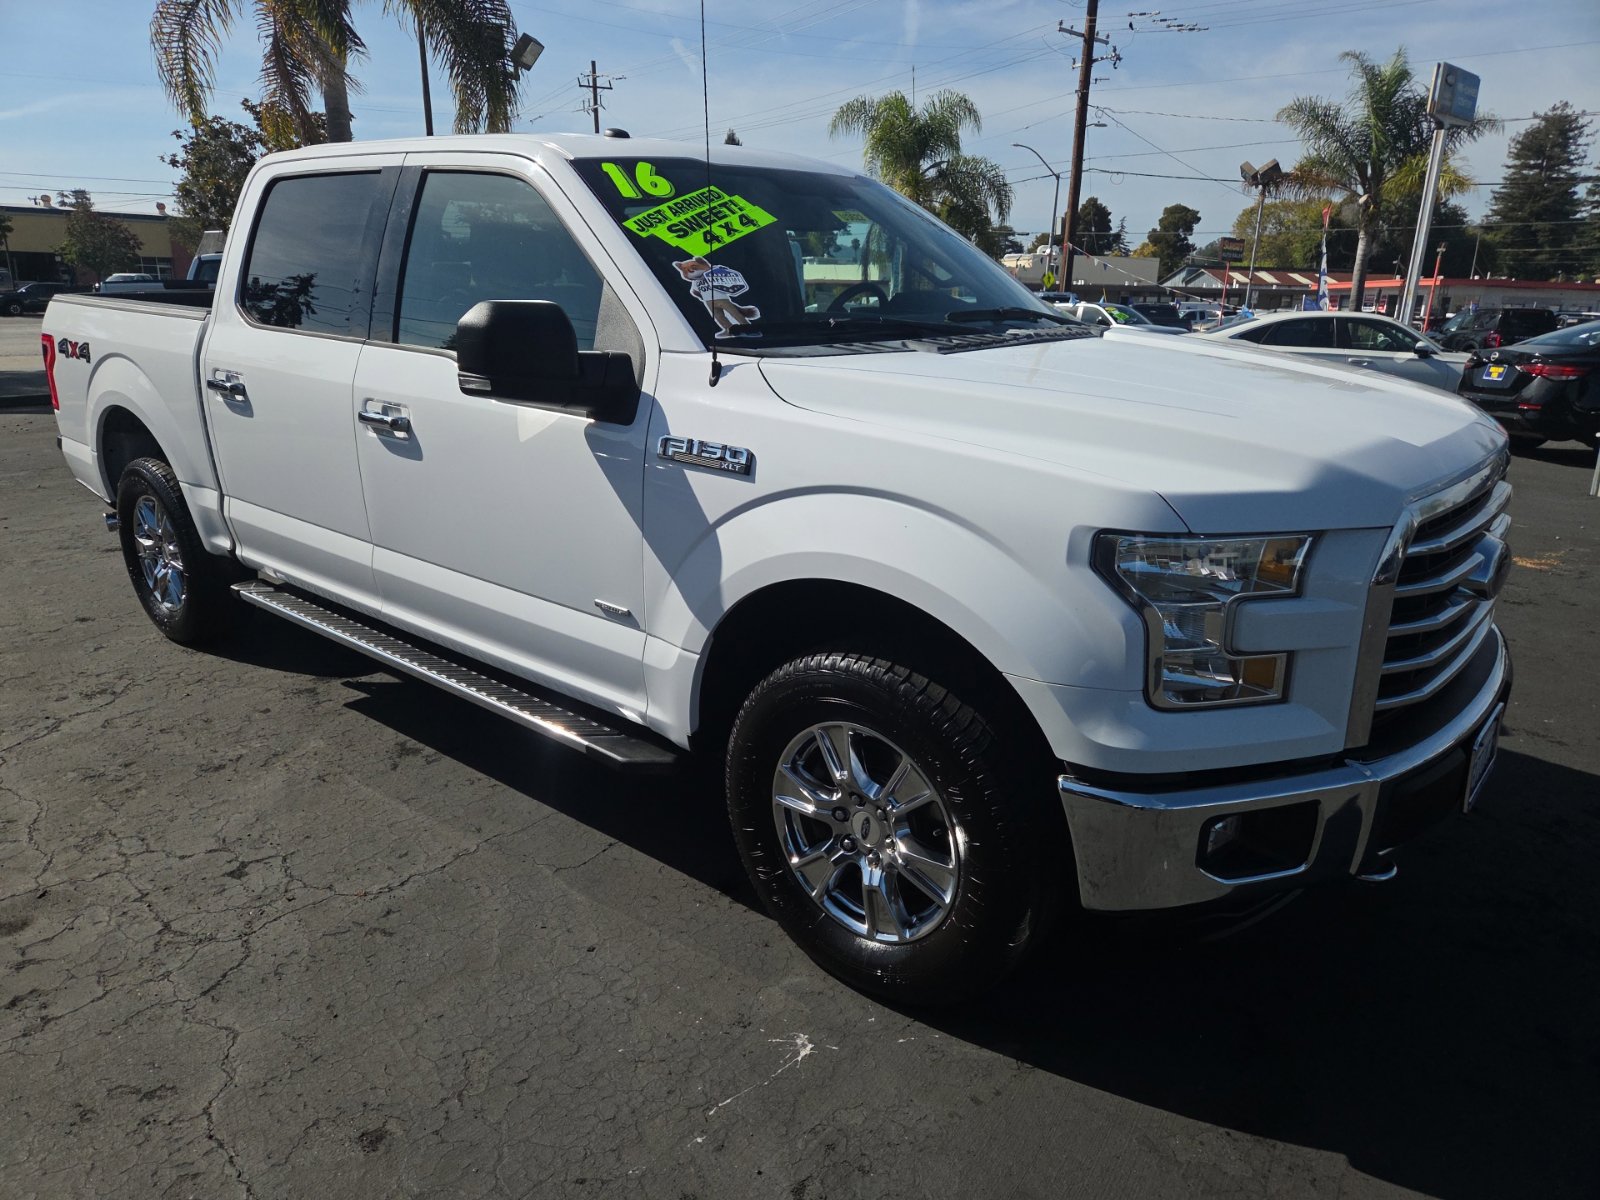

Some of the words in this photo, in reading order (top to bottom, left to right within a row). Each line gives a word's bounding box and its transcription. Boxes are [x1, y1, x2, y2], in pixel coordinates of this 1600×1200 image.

[602, 161, 675, 198] 16
[633, 209, 671, 233] JUST
[667, 189, 724, 217] ARRIVED
[667, 199, 745, 239] SWEET!
[721, 461, 742, 472] XLT
